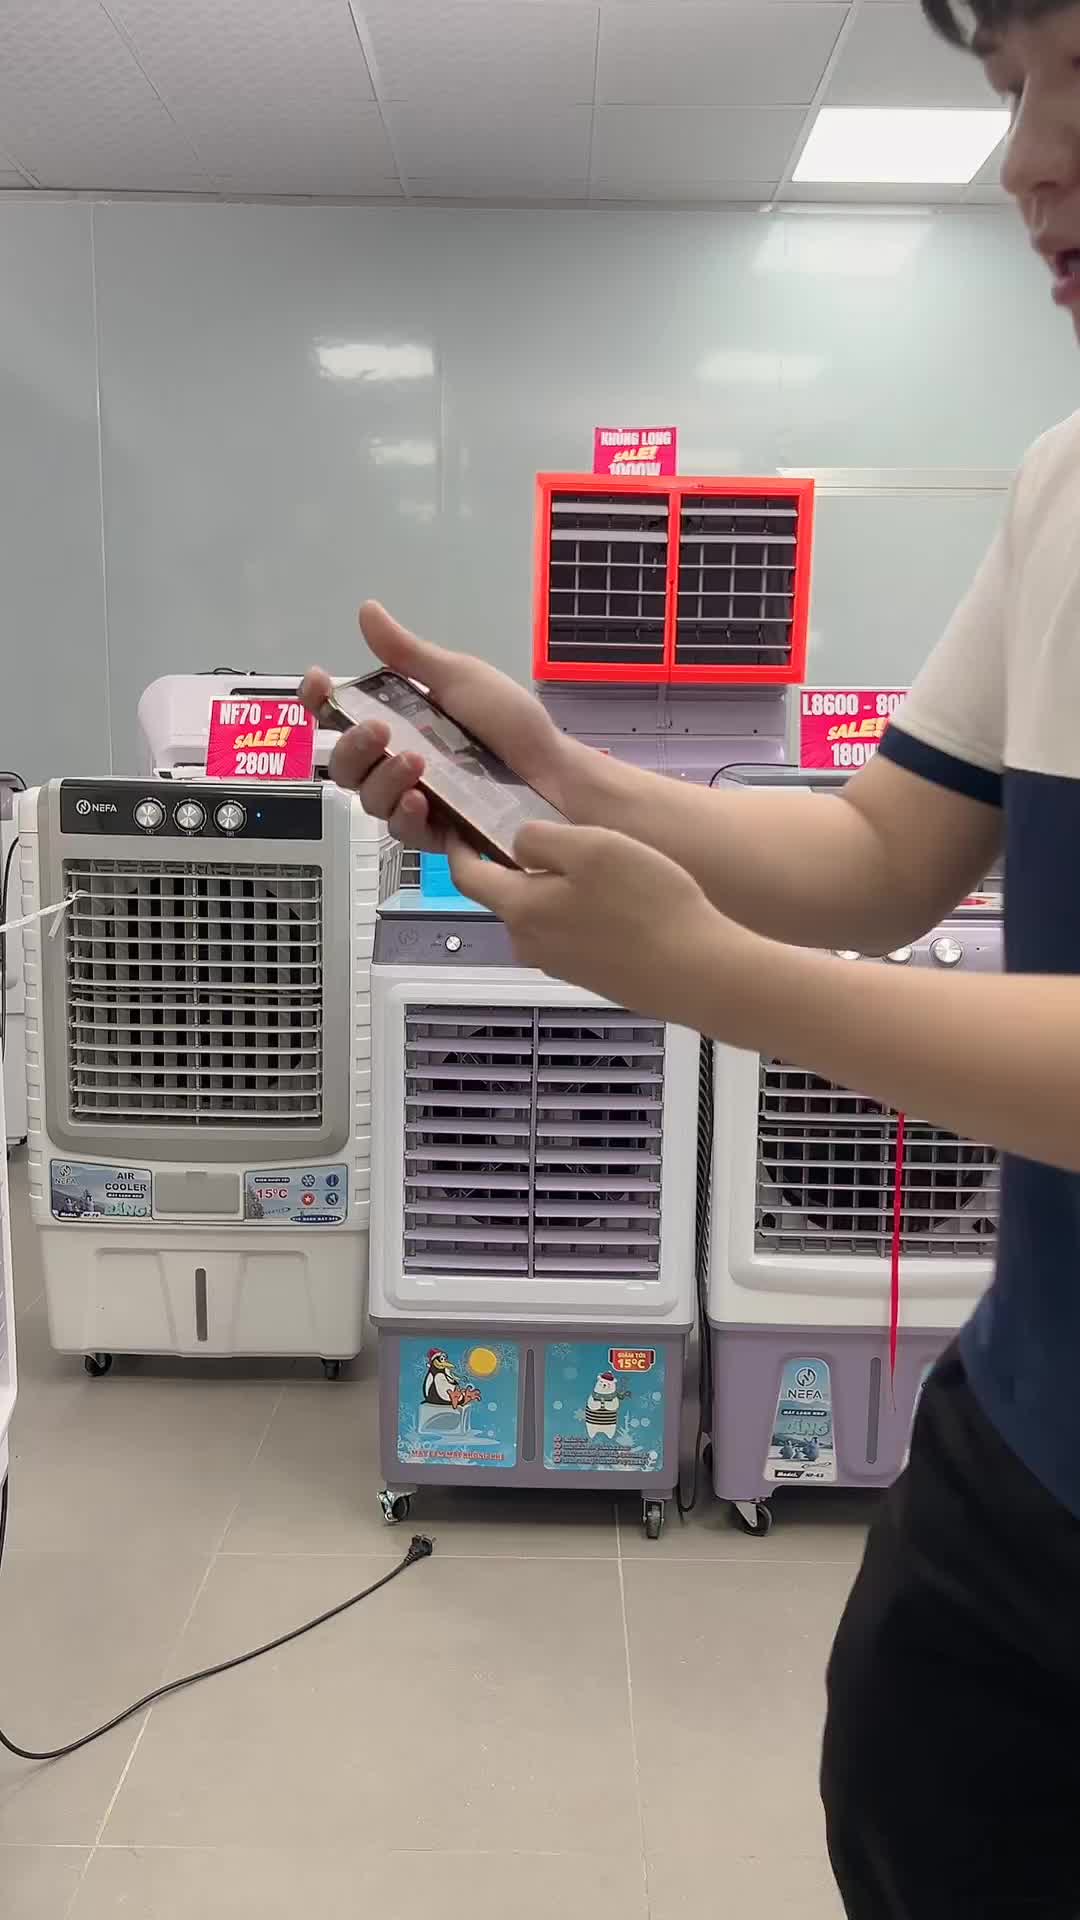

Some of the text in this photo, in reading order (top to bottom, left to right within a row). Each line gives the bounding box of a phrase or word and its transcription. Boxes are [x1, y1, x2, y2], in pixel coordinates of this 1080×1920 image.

[641, 431, 672, 446] LONG
[613, 446, 659, 462] SALE!
[802, 693, 859, 716] L8600
[876, 693, 905, 716] 80
[220, 703, 261, 725] NF70
[277, 703, 308, 726] 70L
[826, 716, 887, 741] SALE!
[233, 726, 292, 750] SALE!
[235, 751, 286, 775] 280W
[92, 803, 118, 813] NEFA
[117, 1172, 135, 1180] AIR
[105, 1183, 147, 1192] COOLER
[788, 1389, 822, 1399] NEFA
